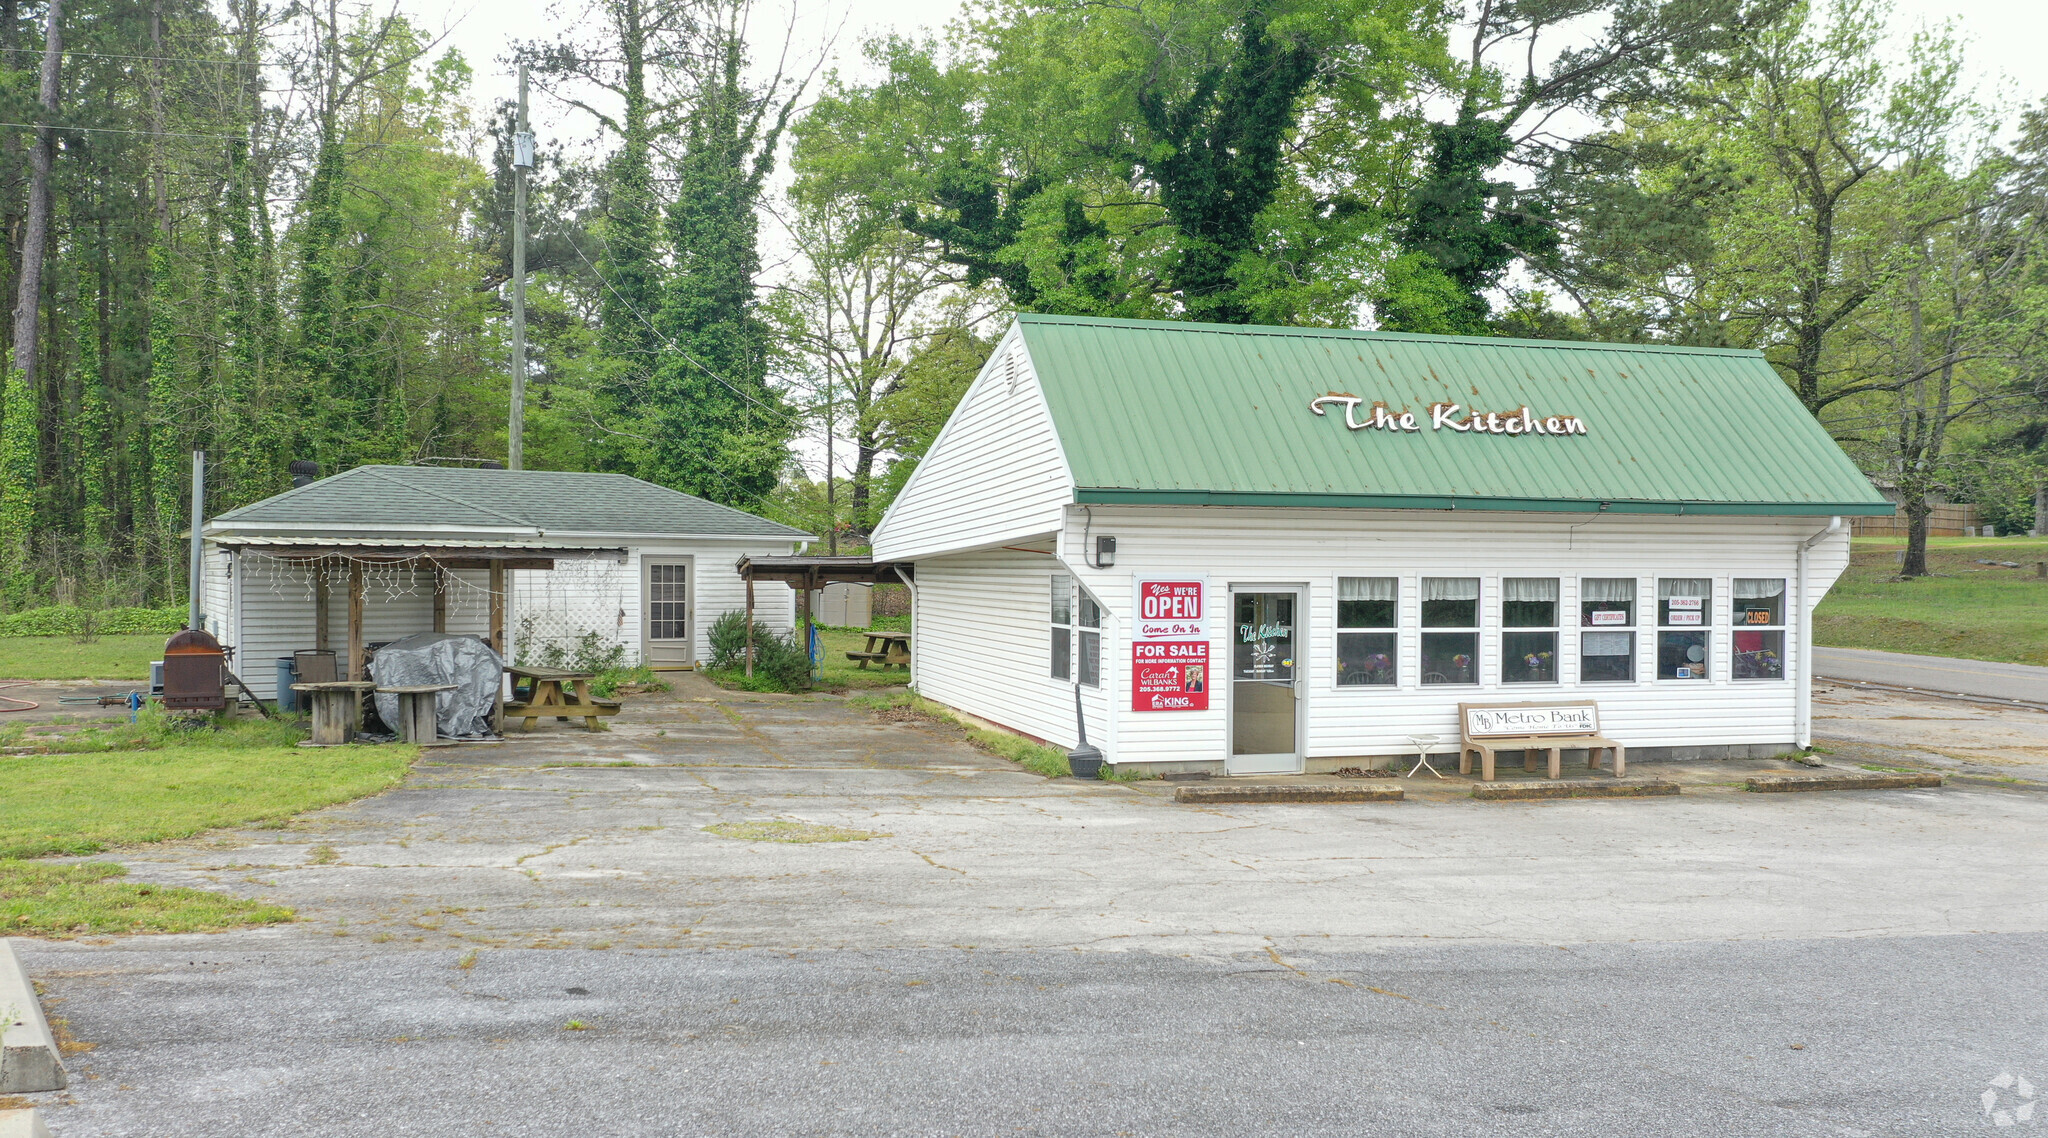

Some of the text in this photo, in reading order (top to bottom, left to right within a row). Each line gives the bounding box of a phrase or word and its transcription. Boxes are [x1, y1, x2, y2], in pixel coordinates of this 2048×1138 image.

[1309, 395, 1588, 434] The Kitchen
[1150, 584, 1198, 597] Yes WE'RE
[1144, 596, 1198, 618] OPEN
[1747, 611, 1769, 624] CLOSED
[1142, 624, 1201, 634] Come On In
[1240, 621, 1288, 642] The Kitchen
[1136, 645, 1206, 657] FOR SALE
[1141, 667, 1170, 679] Caran
[1164, 697, 1189, 706] KING
[1495, 710, 1591, 724] Metro Bank
